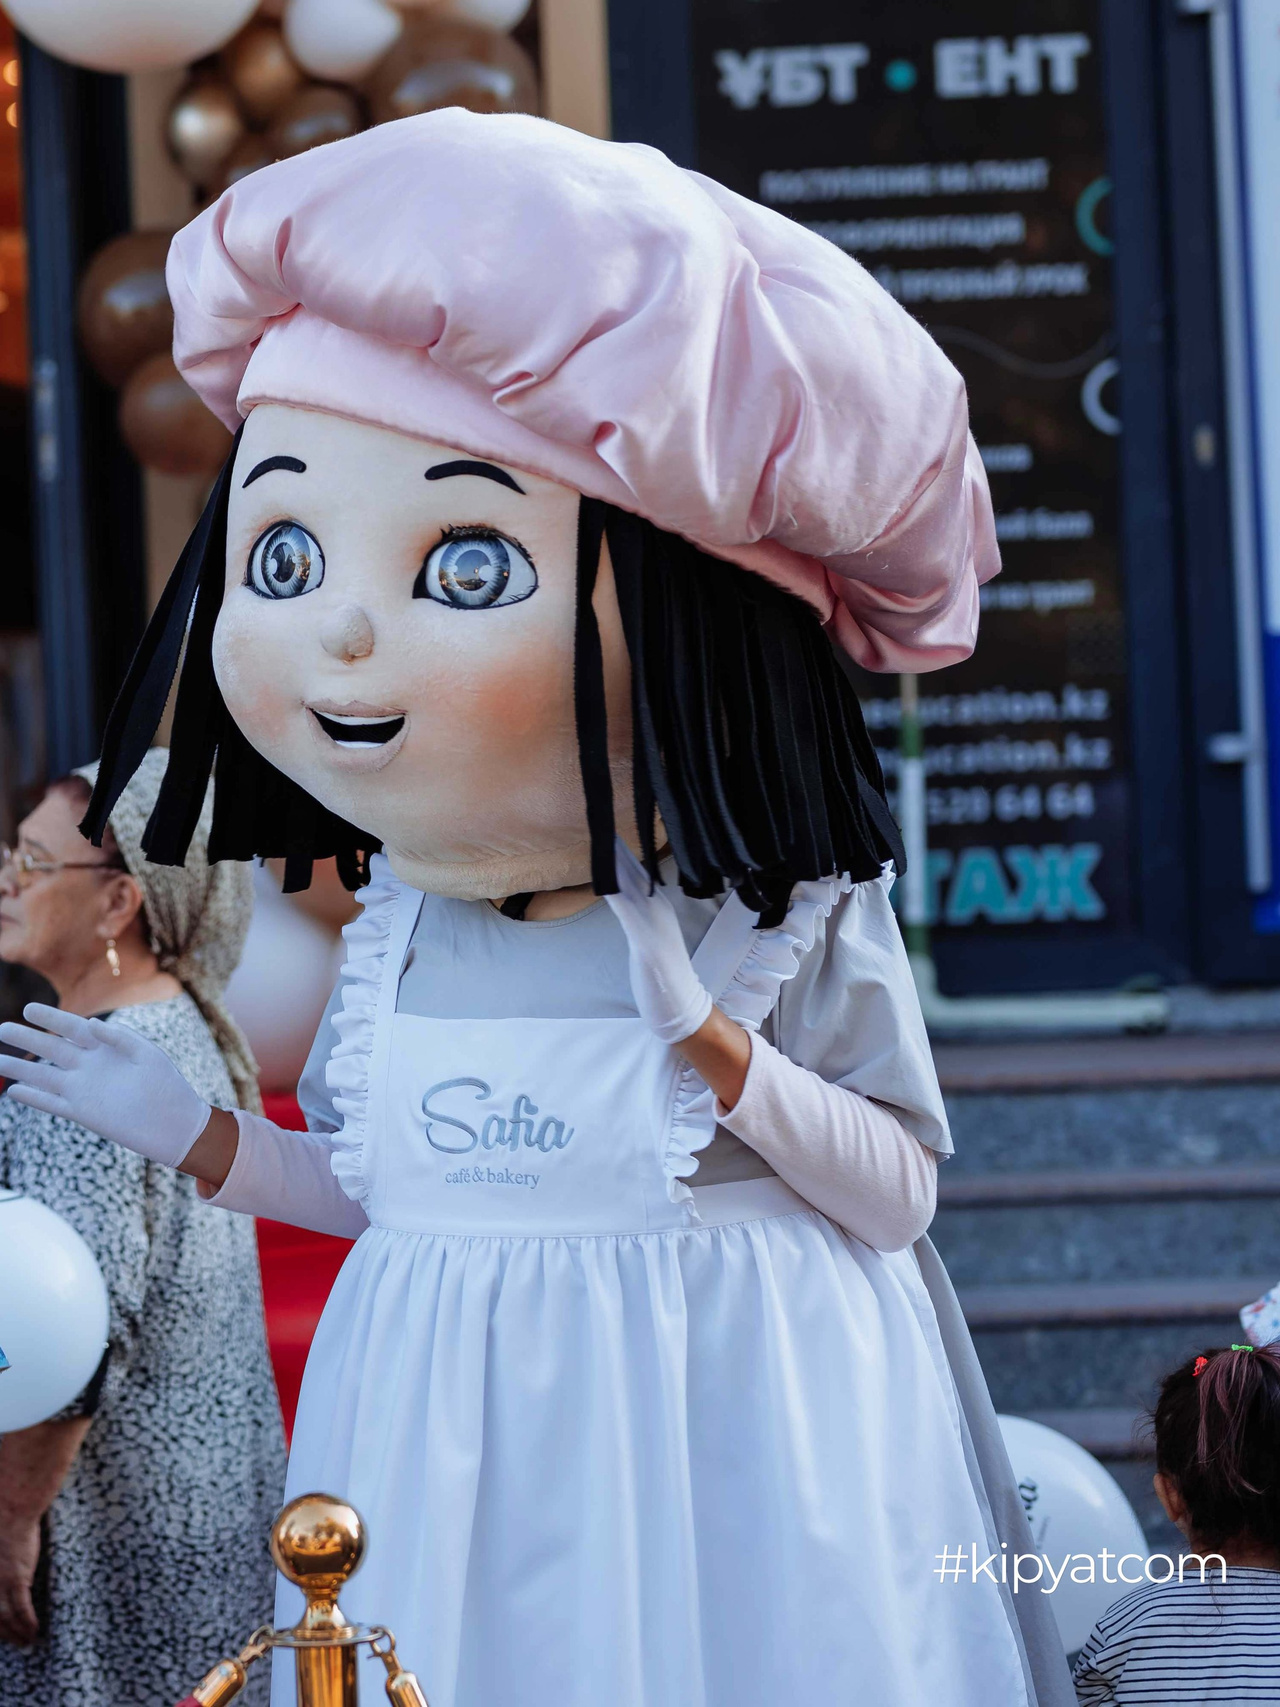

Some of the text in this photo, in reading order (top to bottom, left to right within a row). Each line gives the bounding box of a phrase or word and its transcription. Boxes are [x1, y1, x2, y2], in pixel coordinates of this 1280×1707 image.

[933, 33, 1089, 98] ЕНТ
[995, 784, 1042, 822] 64
[1046, 782, 1095, 820] 64
[422, 1077, 574, 1154] Safia
